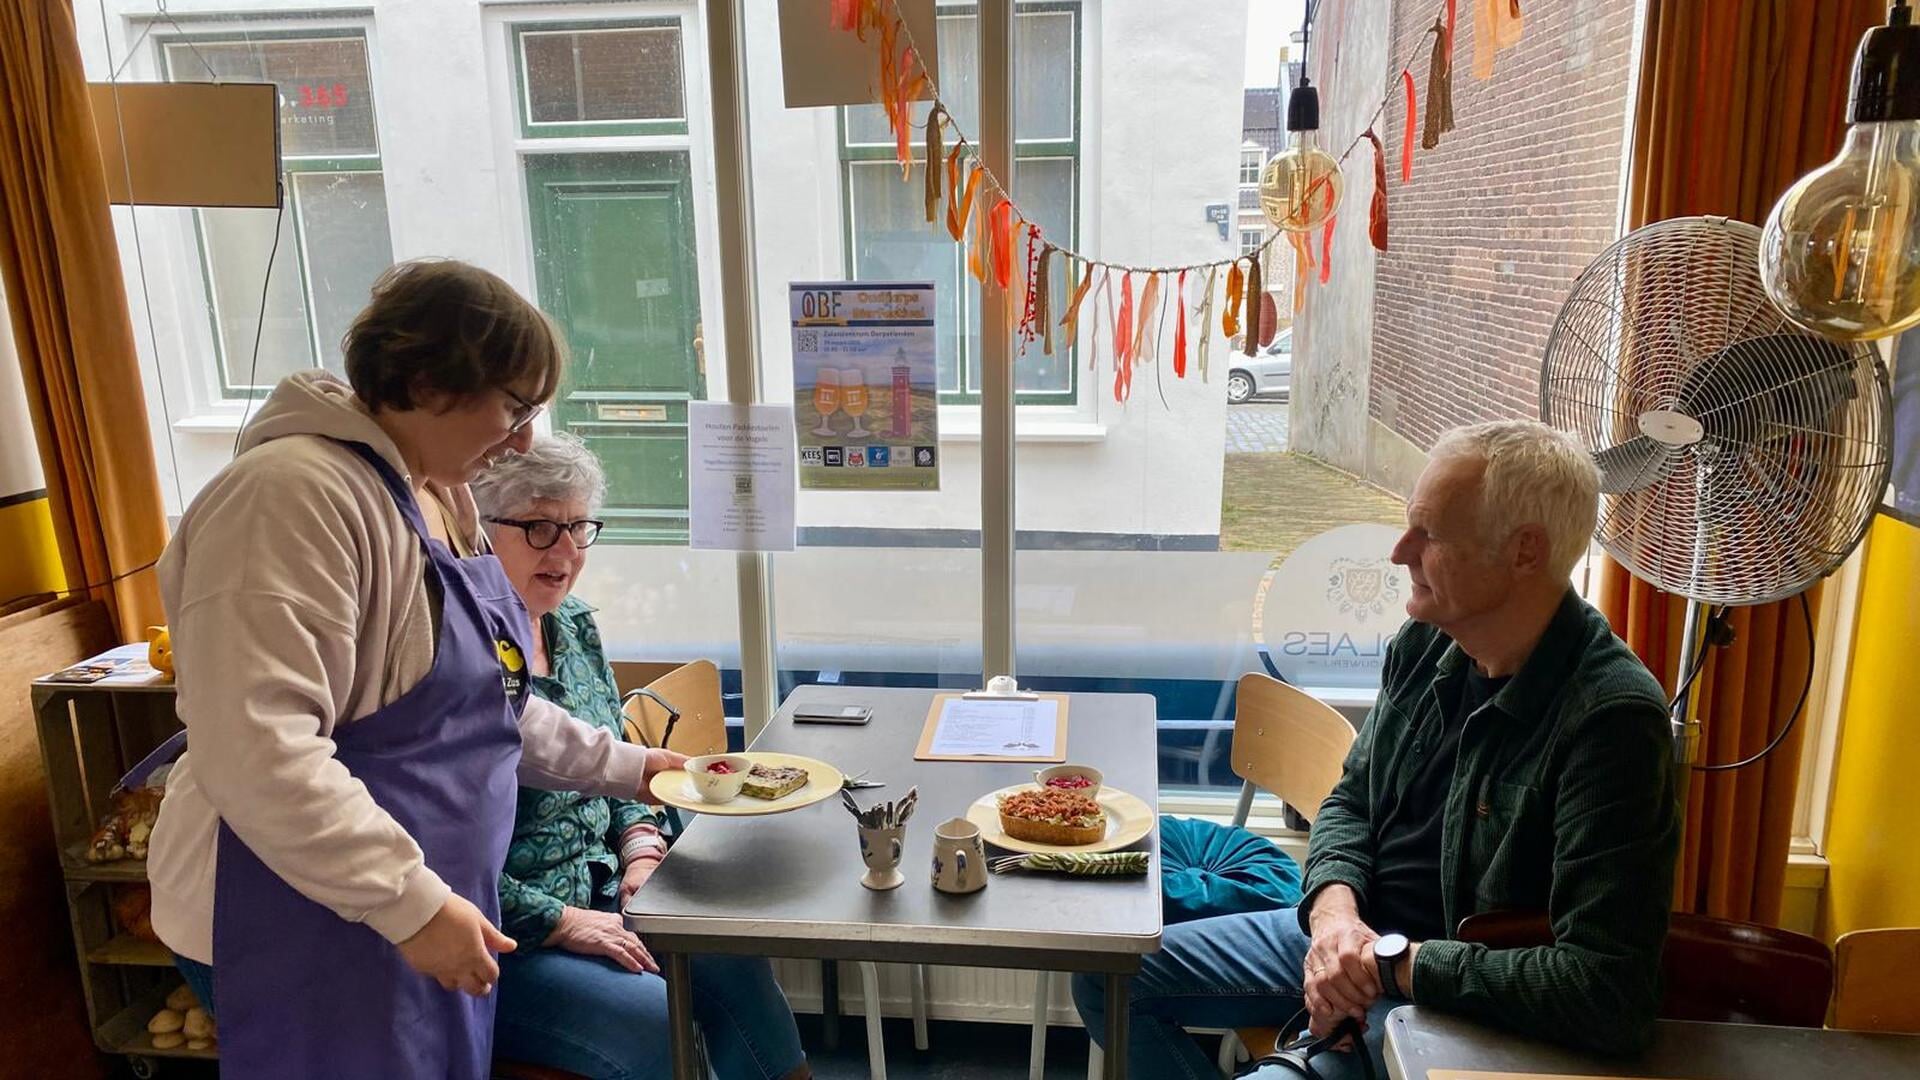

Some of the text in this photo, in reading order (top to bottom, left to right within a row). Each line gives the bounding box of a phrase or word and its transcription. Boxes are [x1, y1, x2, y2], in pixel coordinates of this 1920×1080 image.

[281, 112, 335, 125] arketing
[802, 291, 842, 317] OBF
[802, 450, 822, 460] KEES
[507, 677, 520, 687] Zus
